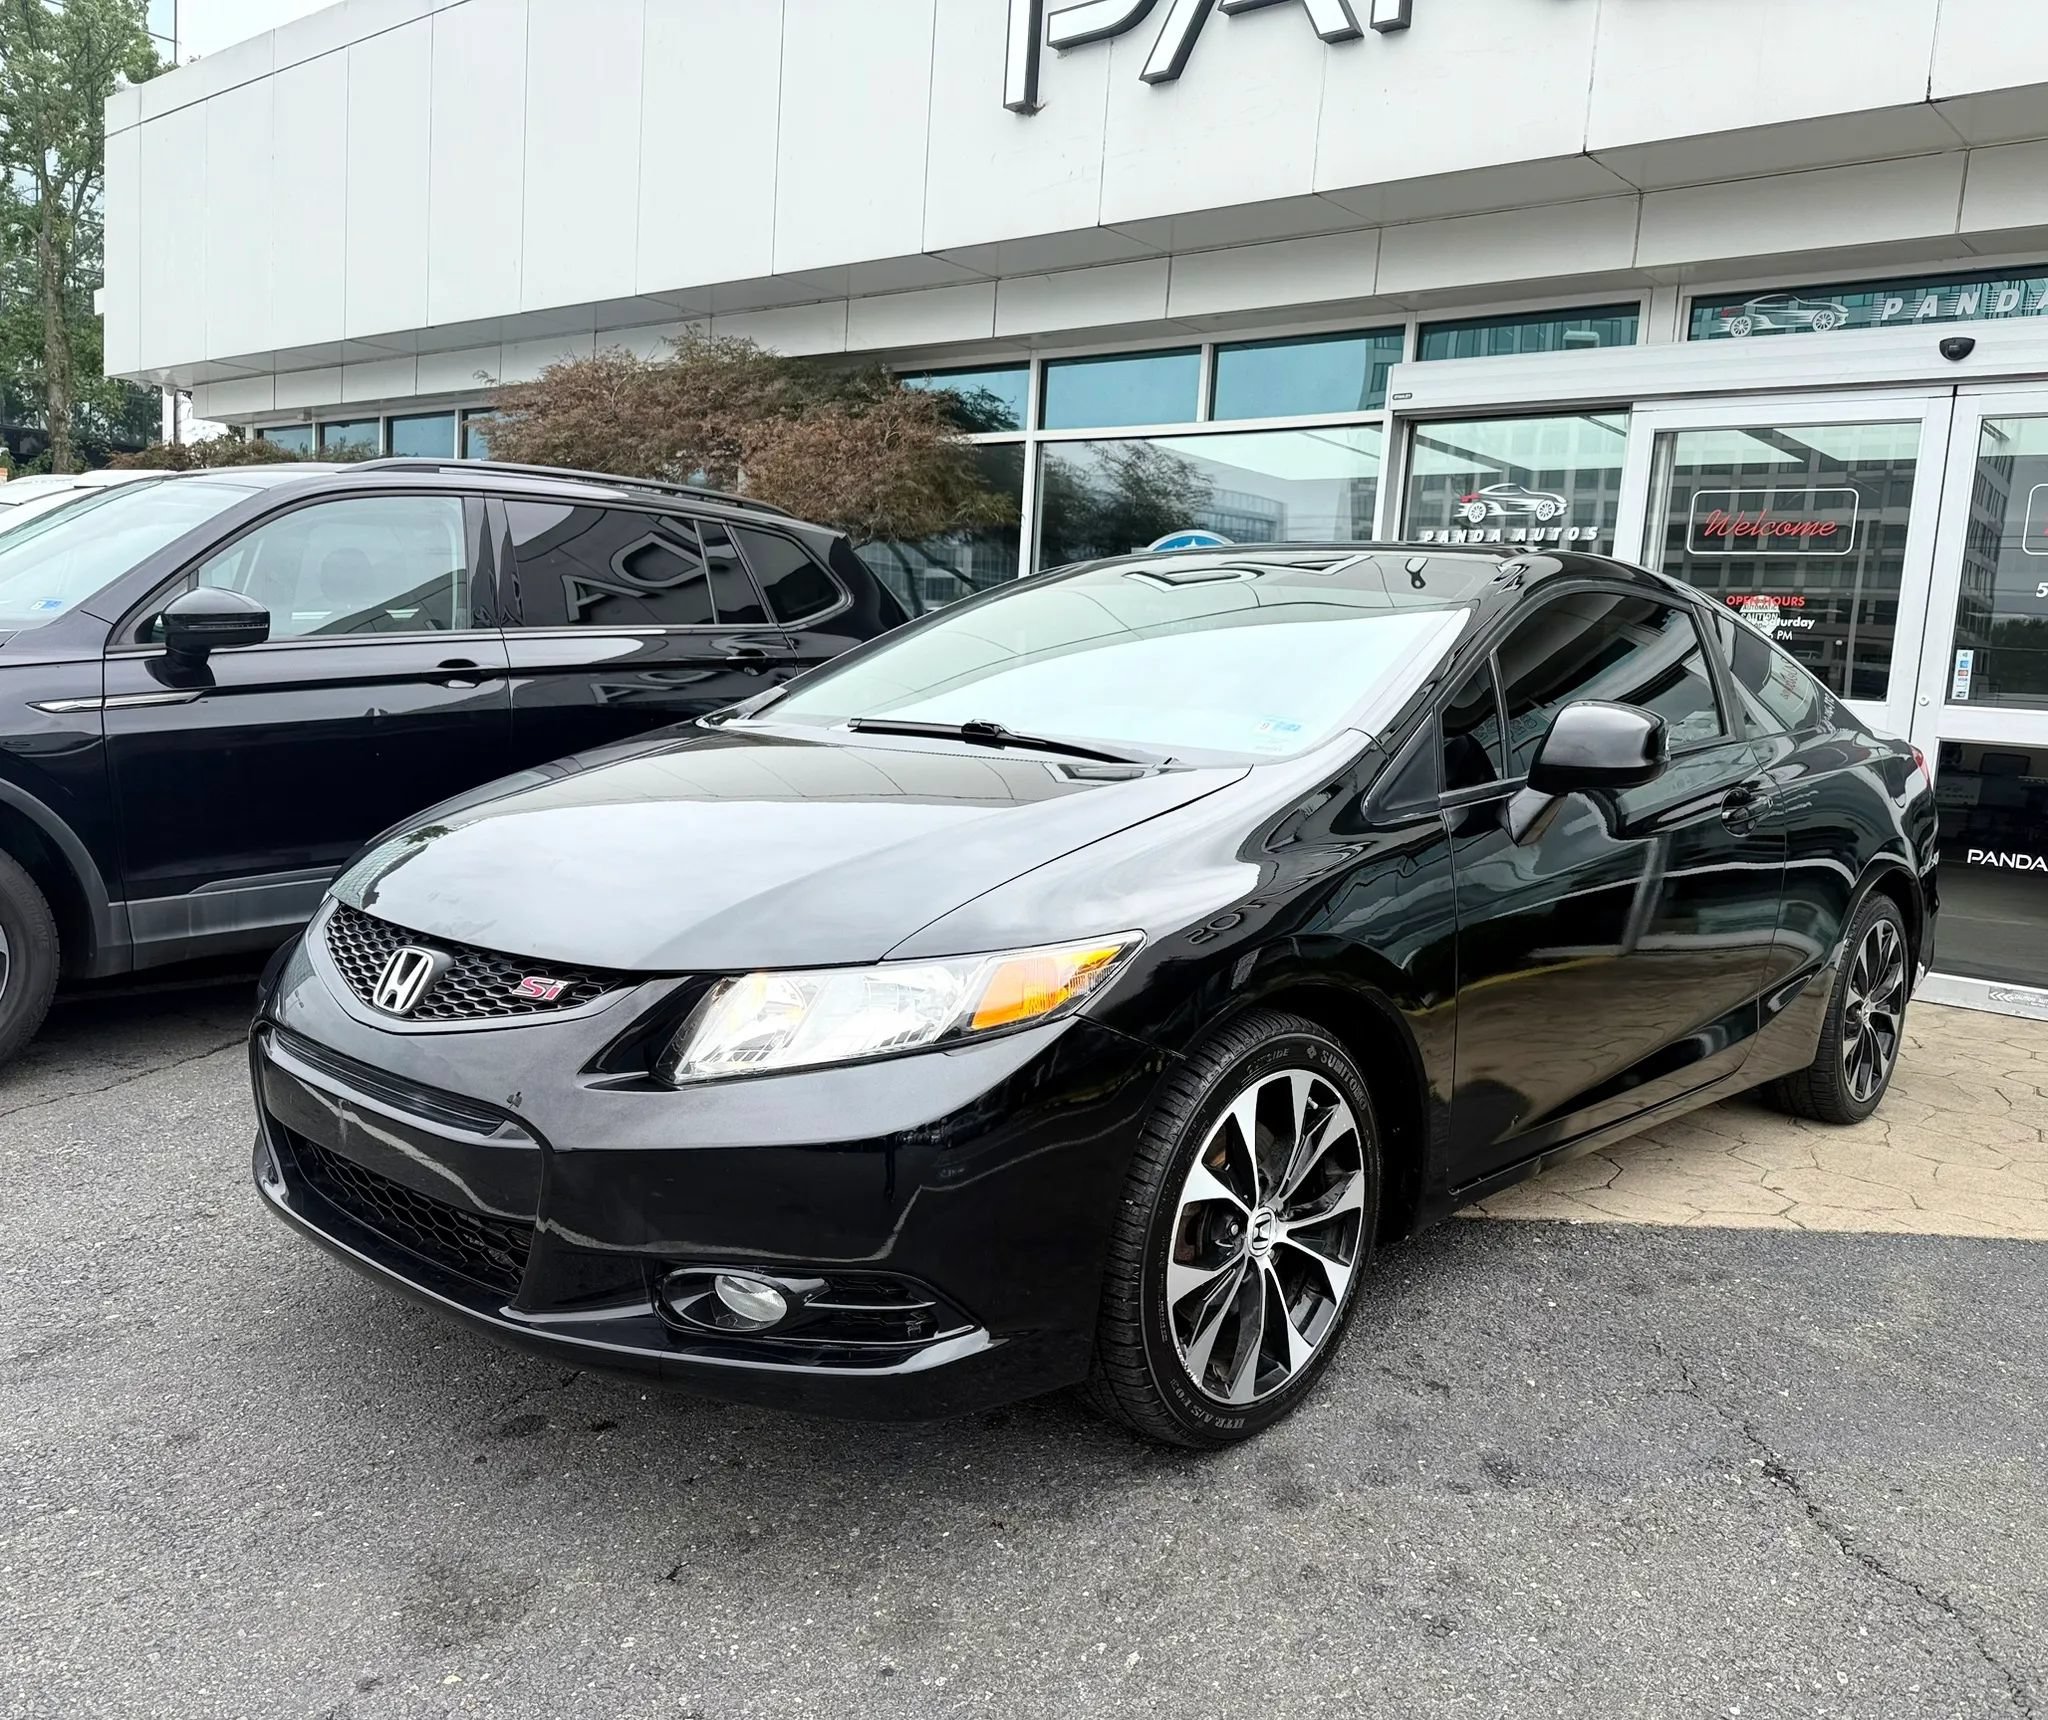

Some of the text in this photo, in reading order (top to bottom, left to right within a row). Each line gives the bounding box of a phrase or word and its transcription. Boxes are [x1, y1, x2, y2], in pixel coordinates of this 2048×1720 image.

[1704, 508, 1838, 537] Welcome
[1421, 526, 1598, 543] PANDA AUTOS
[1740, 613, 1779, 621] CAUTION
[1776, 630, 1793, 641] PM
[1967, 848, 2048, 872] PANDA
[1320, 1049, 1368, 1111] SUMITOMO
